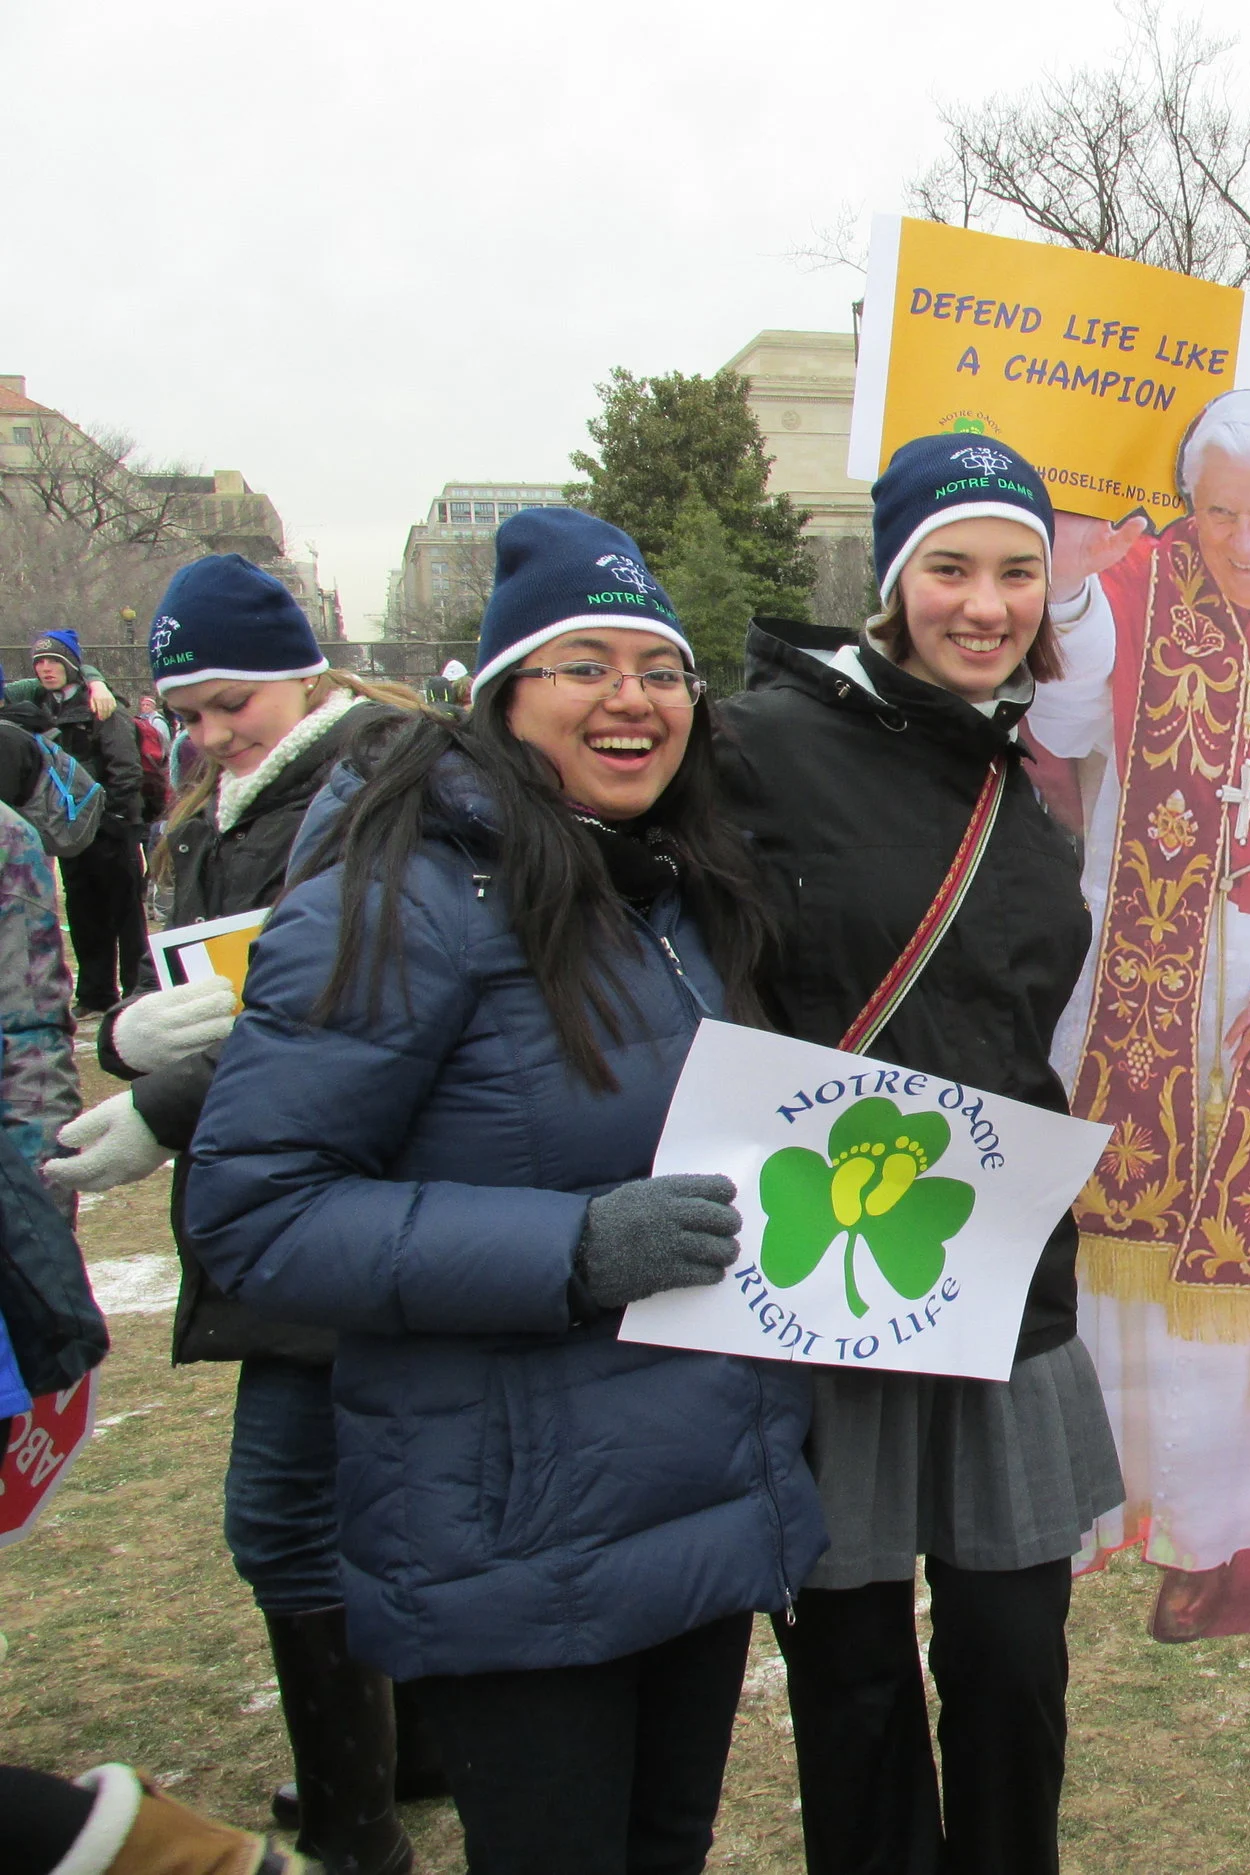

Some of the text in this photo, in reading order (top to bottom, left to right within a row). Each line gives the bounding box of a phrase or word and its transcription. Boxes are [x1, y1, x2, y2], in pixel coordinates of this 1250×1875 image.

[910, 287, 1229, 375] DEFEND LIFE LIKE
[957, 346, 1176, 411] A CHAMPION
[939, 410, 1002, 435] NOTRE DAME
[936, 477, 1034, 501] NOTRE DAME
[1033, 465, 1182, 509] HOOSELIFE.ND.EDU
[587, 591, 646, 606] NOTRE
[163, 651, 194, 666] DAME
[775, 1069, 1005, 1170] NOTRE DAME
[734, 1262, 961, 1361] RIGHT TO LIFE
